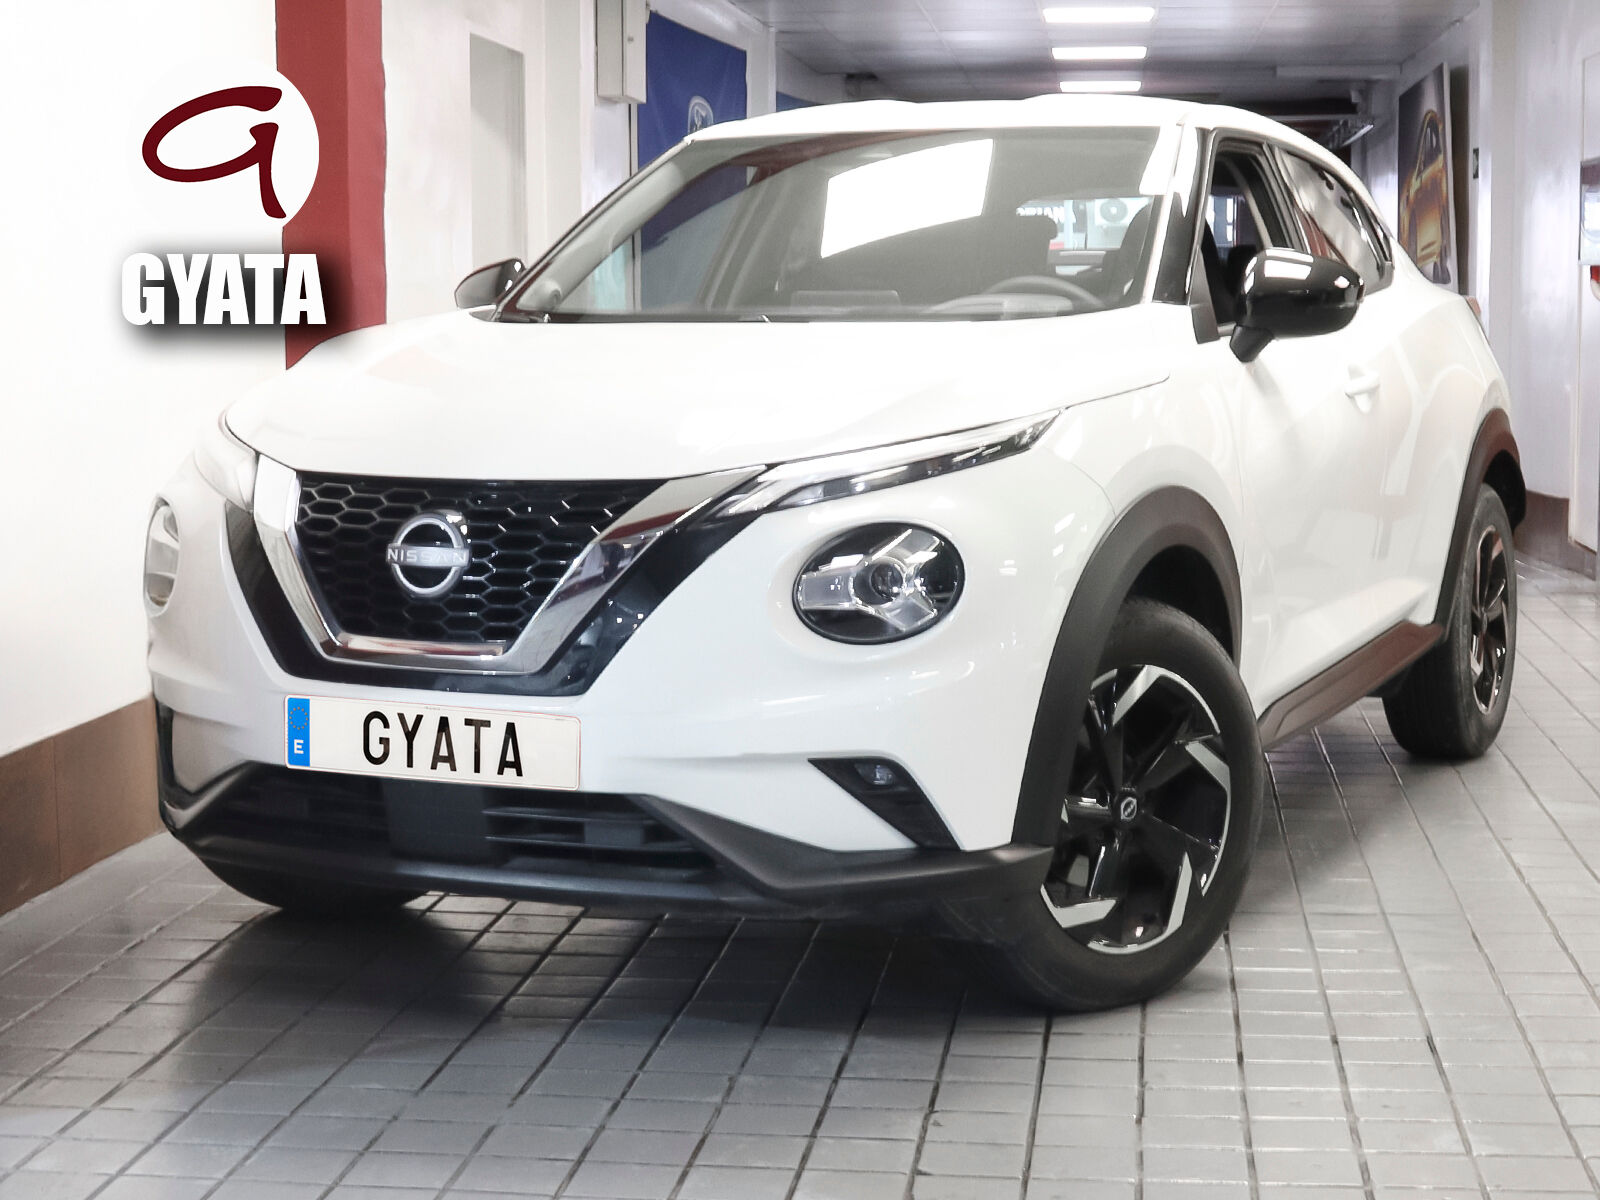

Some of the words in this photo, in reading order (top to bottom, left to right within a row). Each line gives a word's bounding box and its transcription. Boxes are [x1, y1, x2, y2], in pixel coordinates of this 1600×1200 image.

[387, 547, 467, 564] NISSAN
[293, 739, 304, 754] E
[363, 710, 523, 777] GYATA
